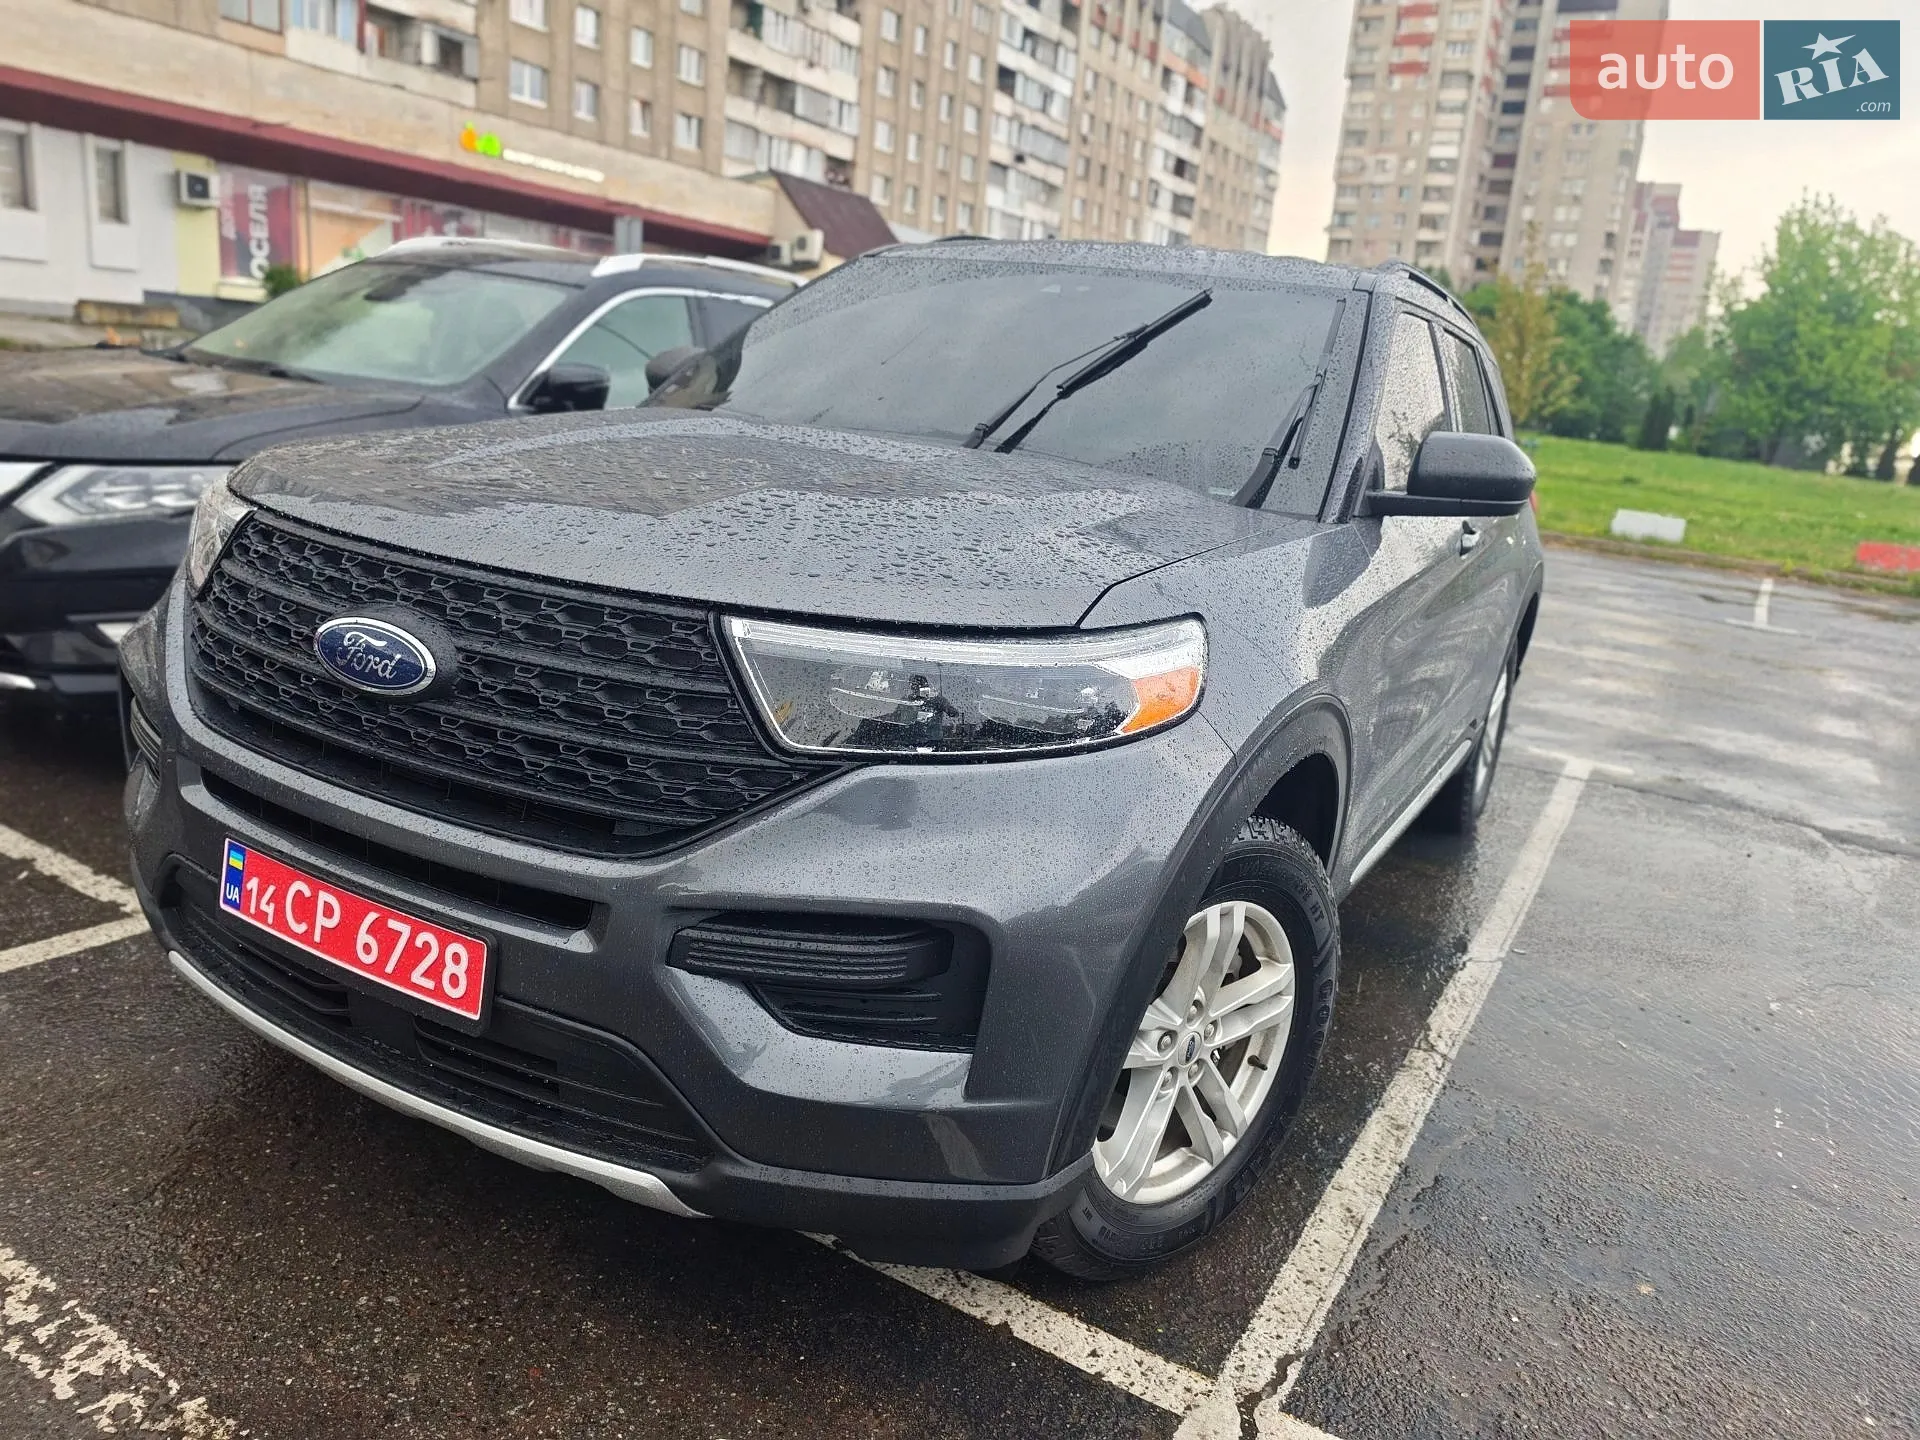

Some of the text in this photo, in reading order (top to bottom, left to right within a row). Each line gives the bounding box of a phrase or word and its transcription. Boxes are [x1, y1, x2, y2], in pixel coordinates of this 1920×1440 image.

[336, 631, 401, 680] Ford
[226, 883, 240, 903] UA
[246, 876, 469, 999] 14 CP 6728
